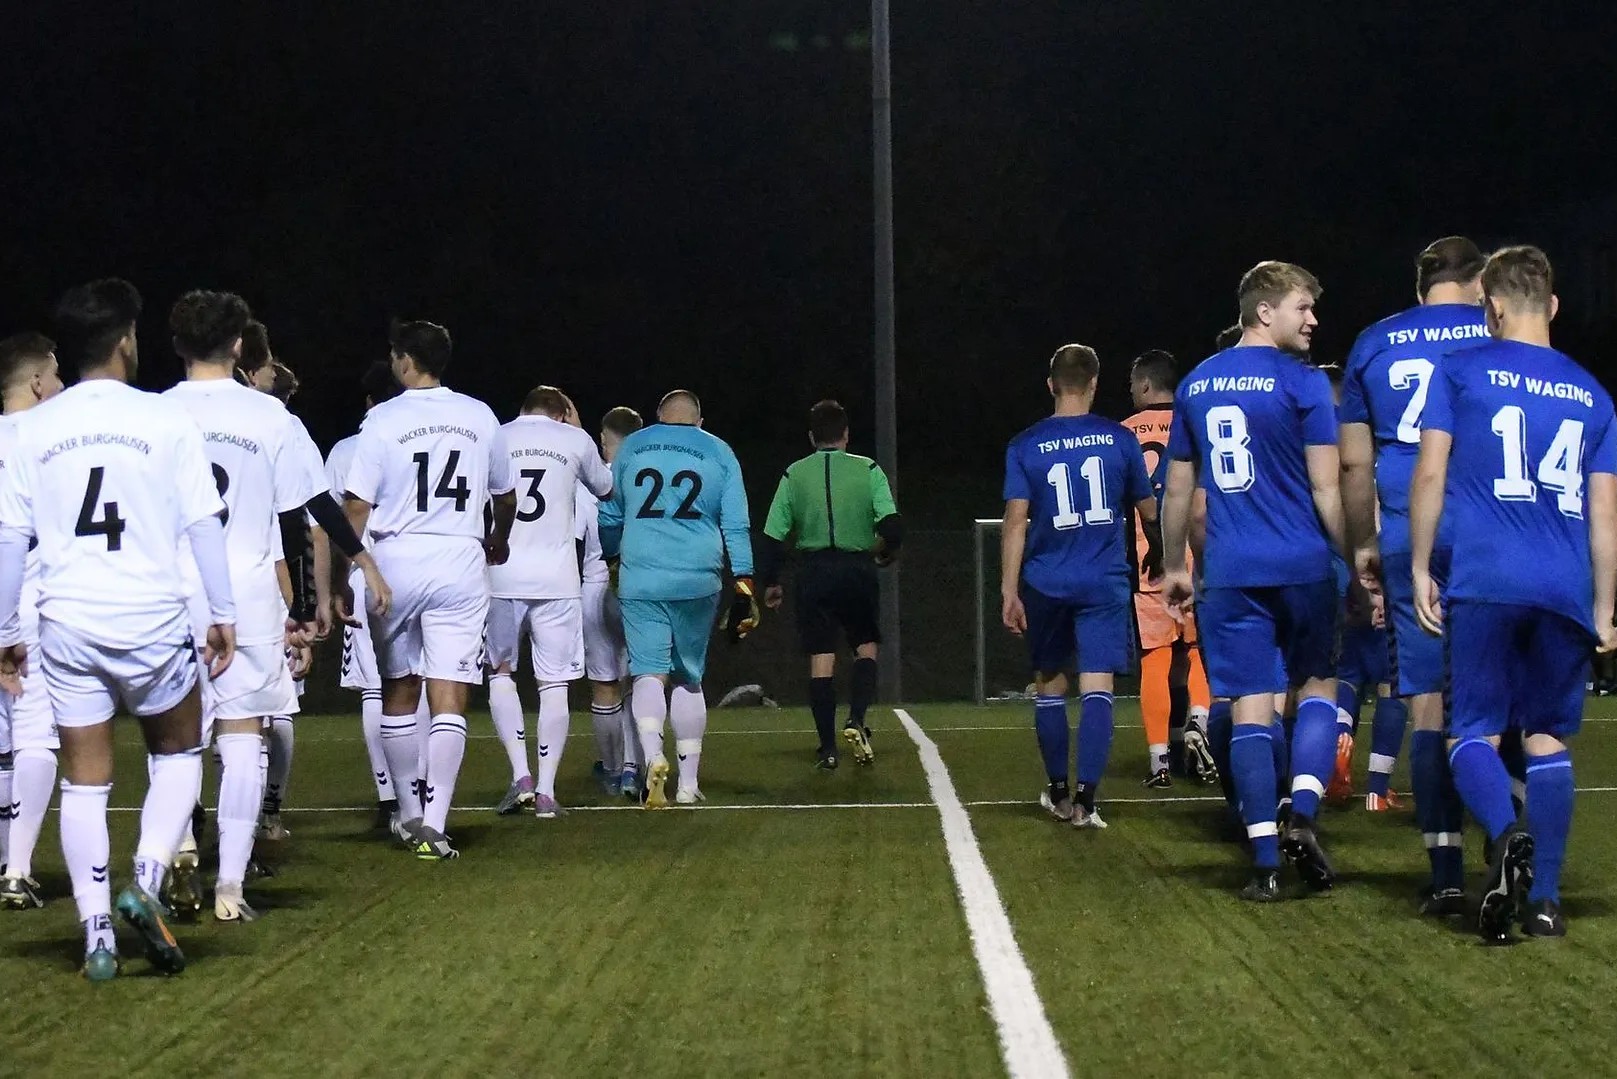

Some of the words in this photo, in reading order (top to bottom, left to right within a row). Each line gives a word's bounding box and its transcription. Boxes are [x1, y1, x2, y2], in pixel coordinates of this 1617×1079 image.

[1387, 329, 1418, 345] TSV
[1188, 378, 1210, 397] TSV
[1212, 376, 1275, 392] WAGING
[1388, 358, 1435, 443] 7
[1487, 369, 1521, 388] TSV
[1525, 376, 1594, 408] WAGING
[39, 438, 78, 465] WACKER
[82, 432, 152, 455] BURGHAUSEN
[397, 427, 428, 445] WACKER
[429, 425, 479, 444] BURGHAUSEN
[1038, 440, 1060, 454] TSV
[1062, 434, 1114, 450] WAGING
[1133, 424, 1153, 434] TSV
[525, 449, 568, 466] BURGHAUSEN
[633, 443, 661, 455] WACKER
[663, 443, 705, 461] BURGHAUSEN
[1205, 405, 1255, 493] 8
[1491, 404, 1585, 520] 14
[413, 450, 471, 512] 14
[516, 468, 547, 522] 3
[634, 467, 703, 520] 22
[1047, 456, 1114, 531] 11
[74, 466, 126, 552] 4
